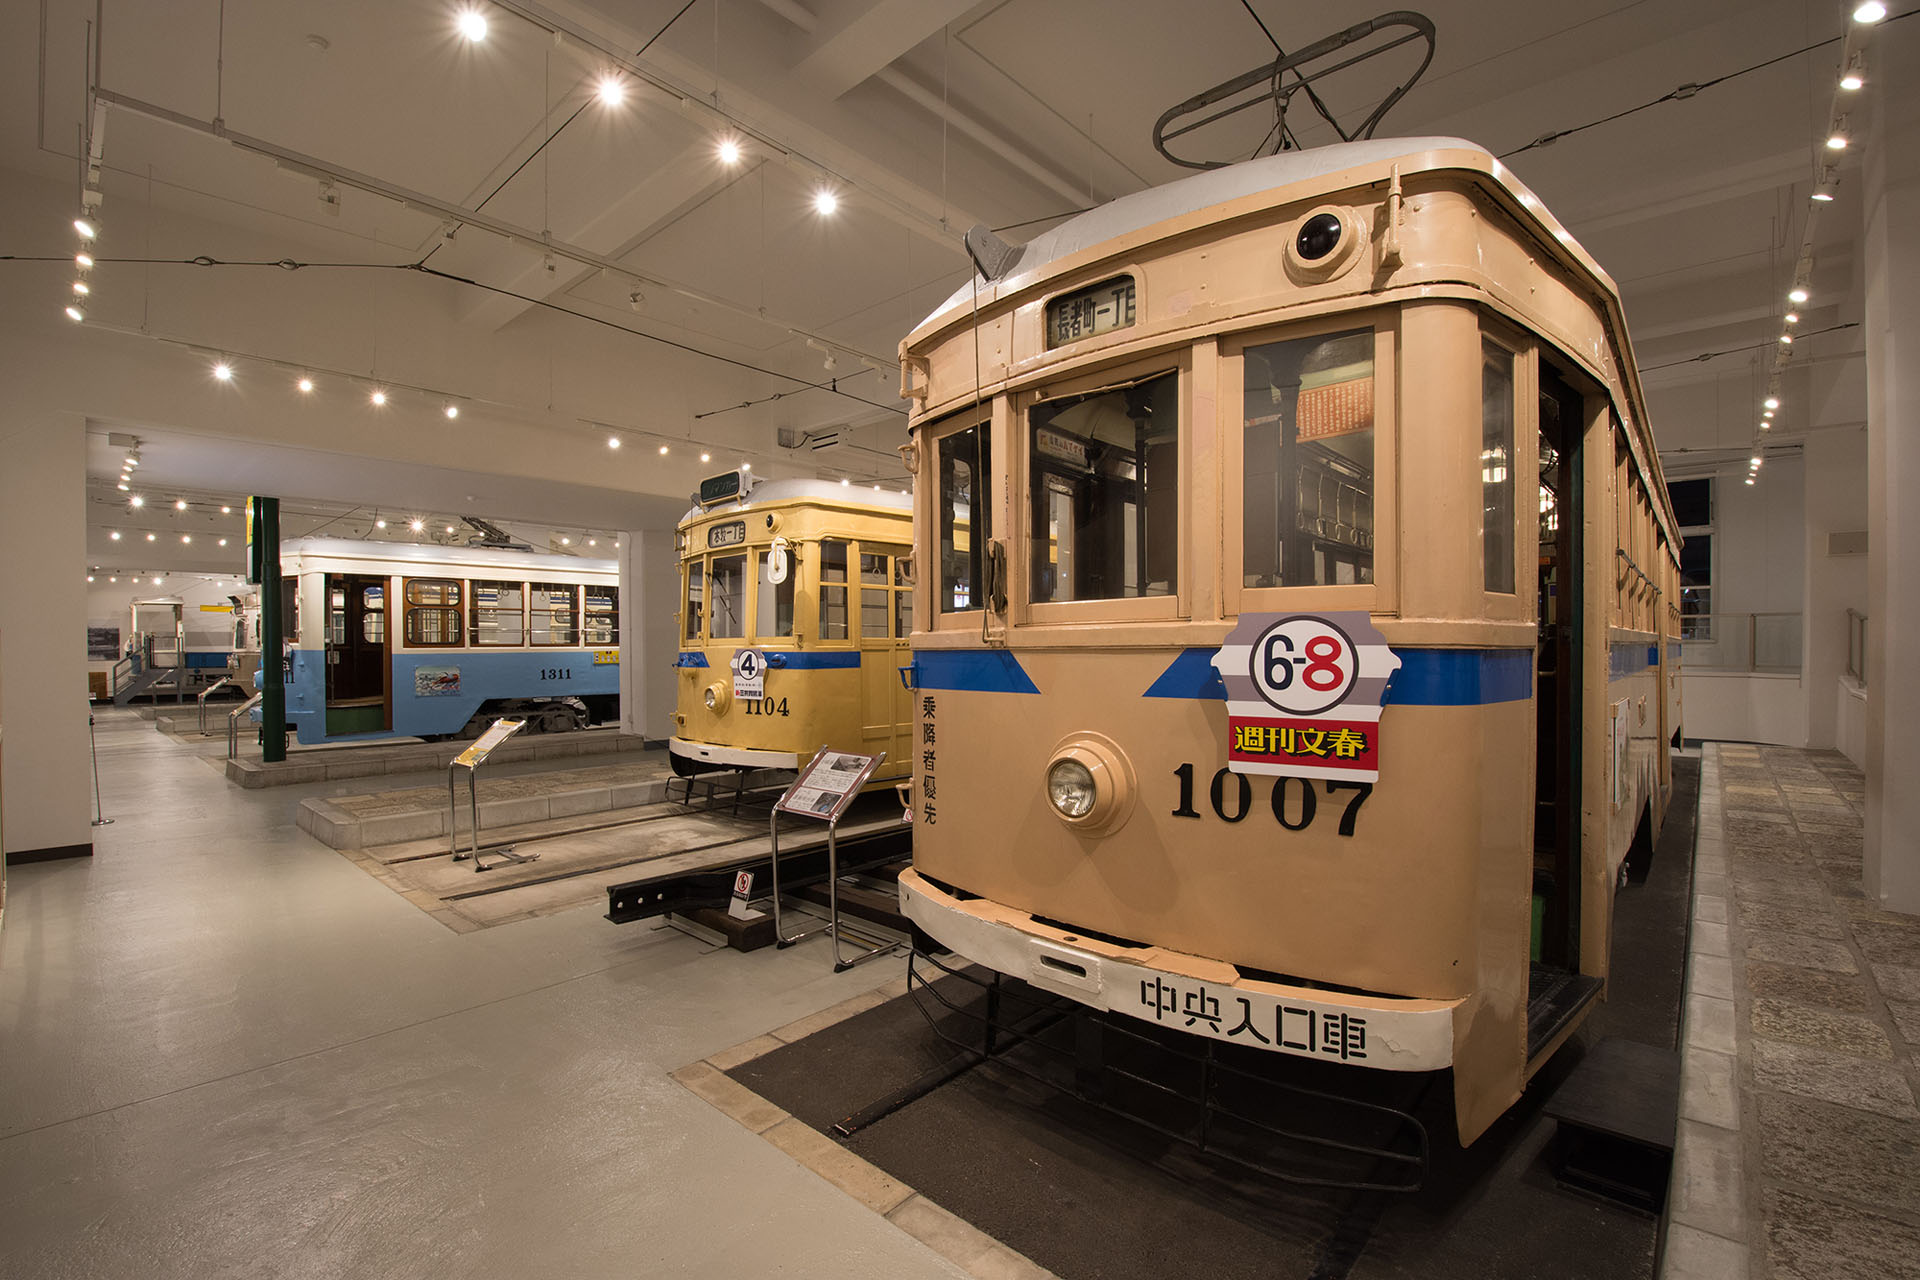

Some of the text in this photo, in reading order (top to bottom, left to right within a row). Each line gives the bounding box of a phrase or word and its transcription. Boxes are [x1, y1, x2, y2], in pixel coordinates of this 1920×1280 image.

[540, 669, 572, 680] 1311
[741, 653, 756, 675] 4
[1264, 634, 1344, 692] 6-8
[745, 696, 790, 717] 1104
[923, 695, 937, 825] 乗降者優先
[1234, 726, 1370, 761] 週刊文春
[1171, 762, 1374, 837] 1007
[1140, 976, 1368, 1060] 中央入口車
